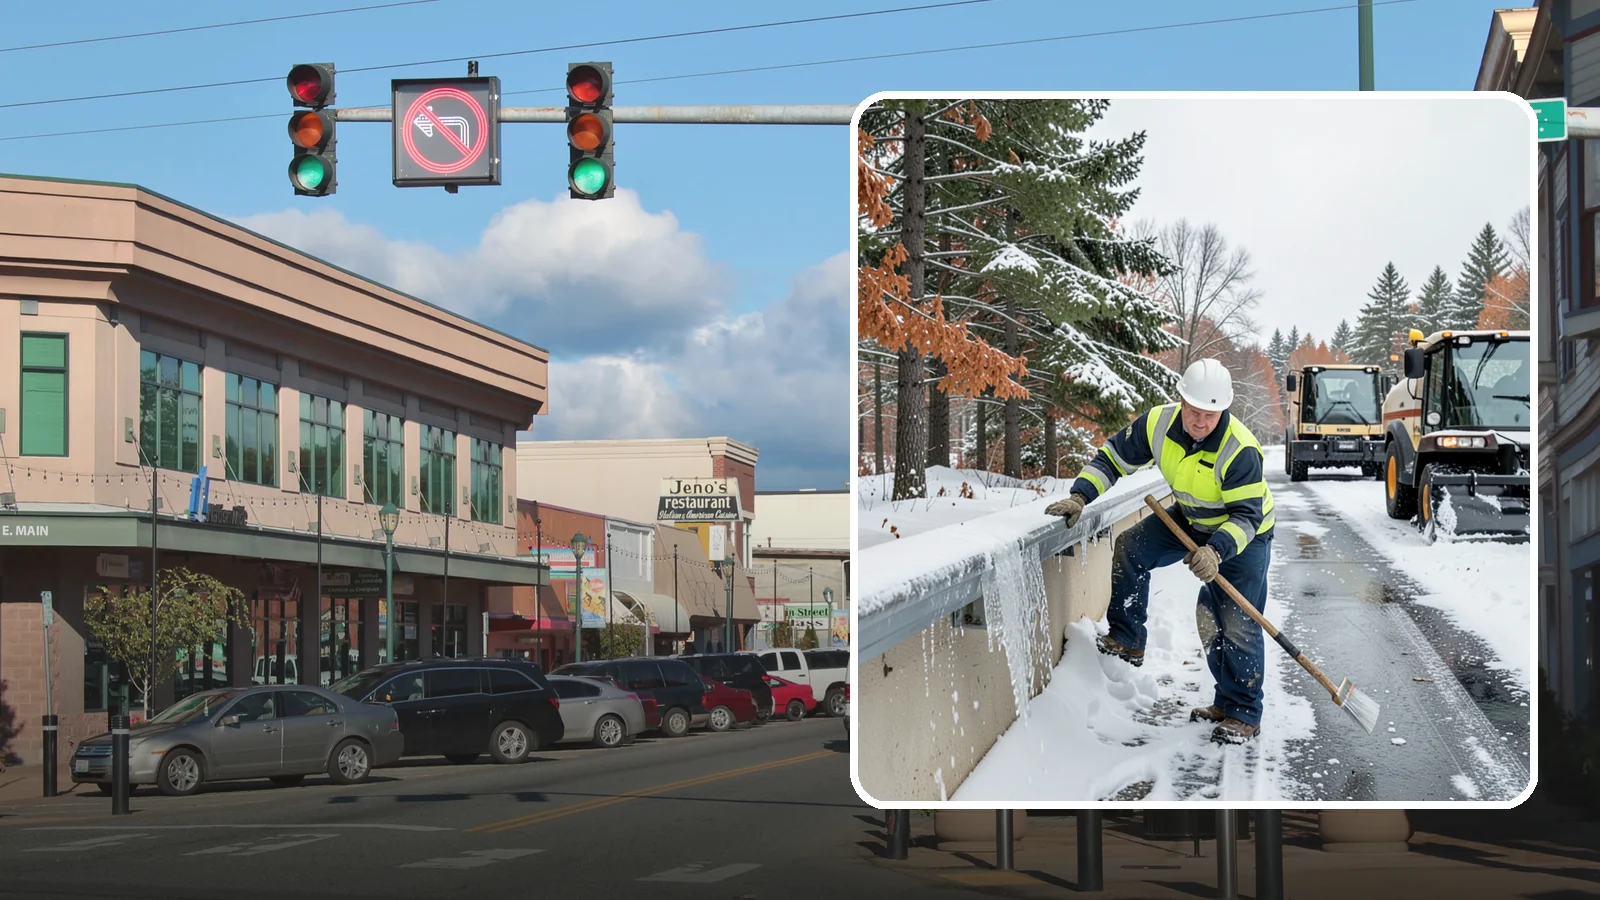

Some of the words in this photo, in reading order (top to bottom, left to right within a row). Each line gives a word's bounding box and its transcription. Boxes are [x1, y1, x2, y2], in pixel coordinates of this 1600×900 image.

[669, 480, 728, 494] Jeno's
[665, 496, 731, 509] restaurant
[658, 510, 681, 519] Italian
[685, 510, 714, 519] American
[714, 509, 738, 519] Cuisine
[2, 525, 13, 536] E.
[15, 525, 49, 536] MAIN
[797, 607, 828, 616] Street
